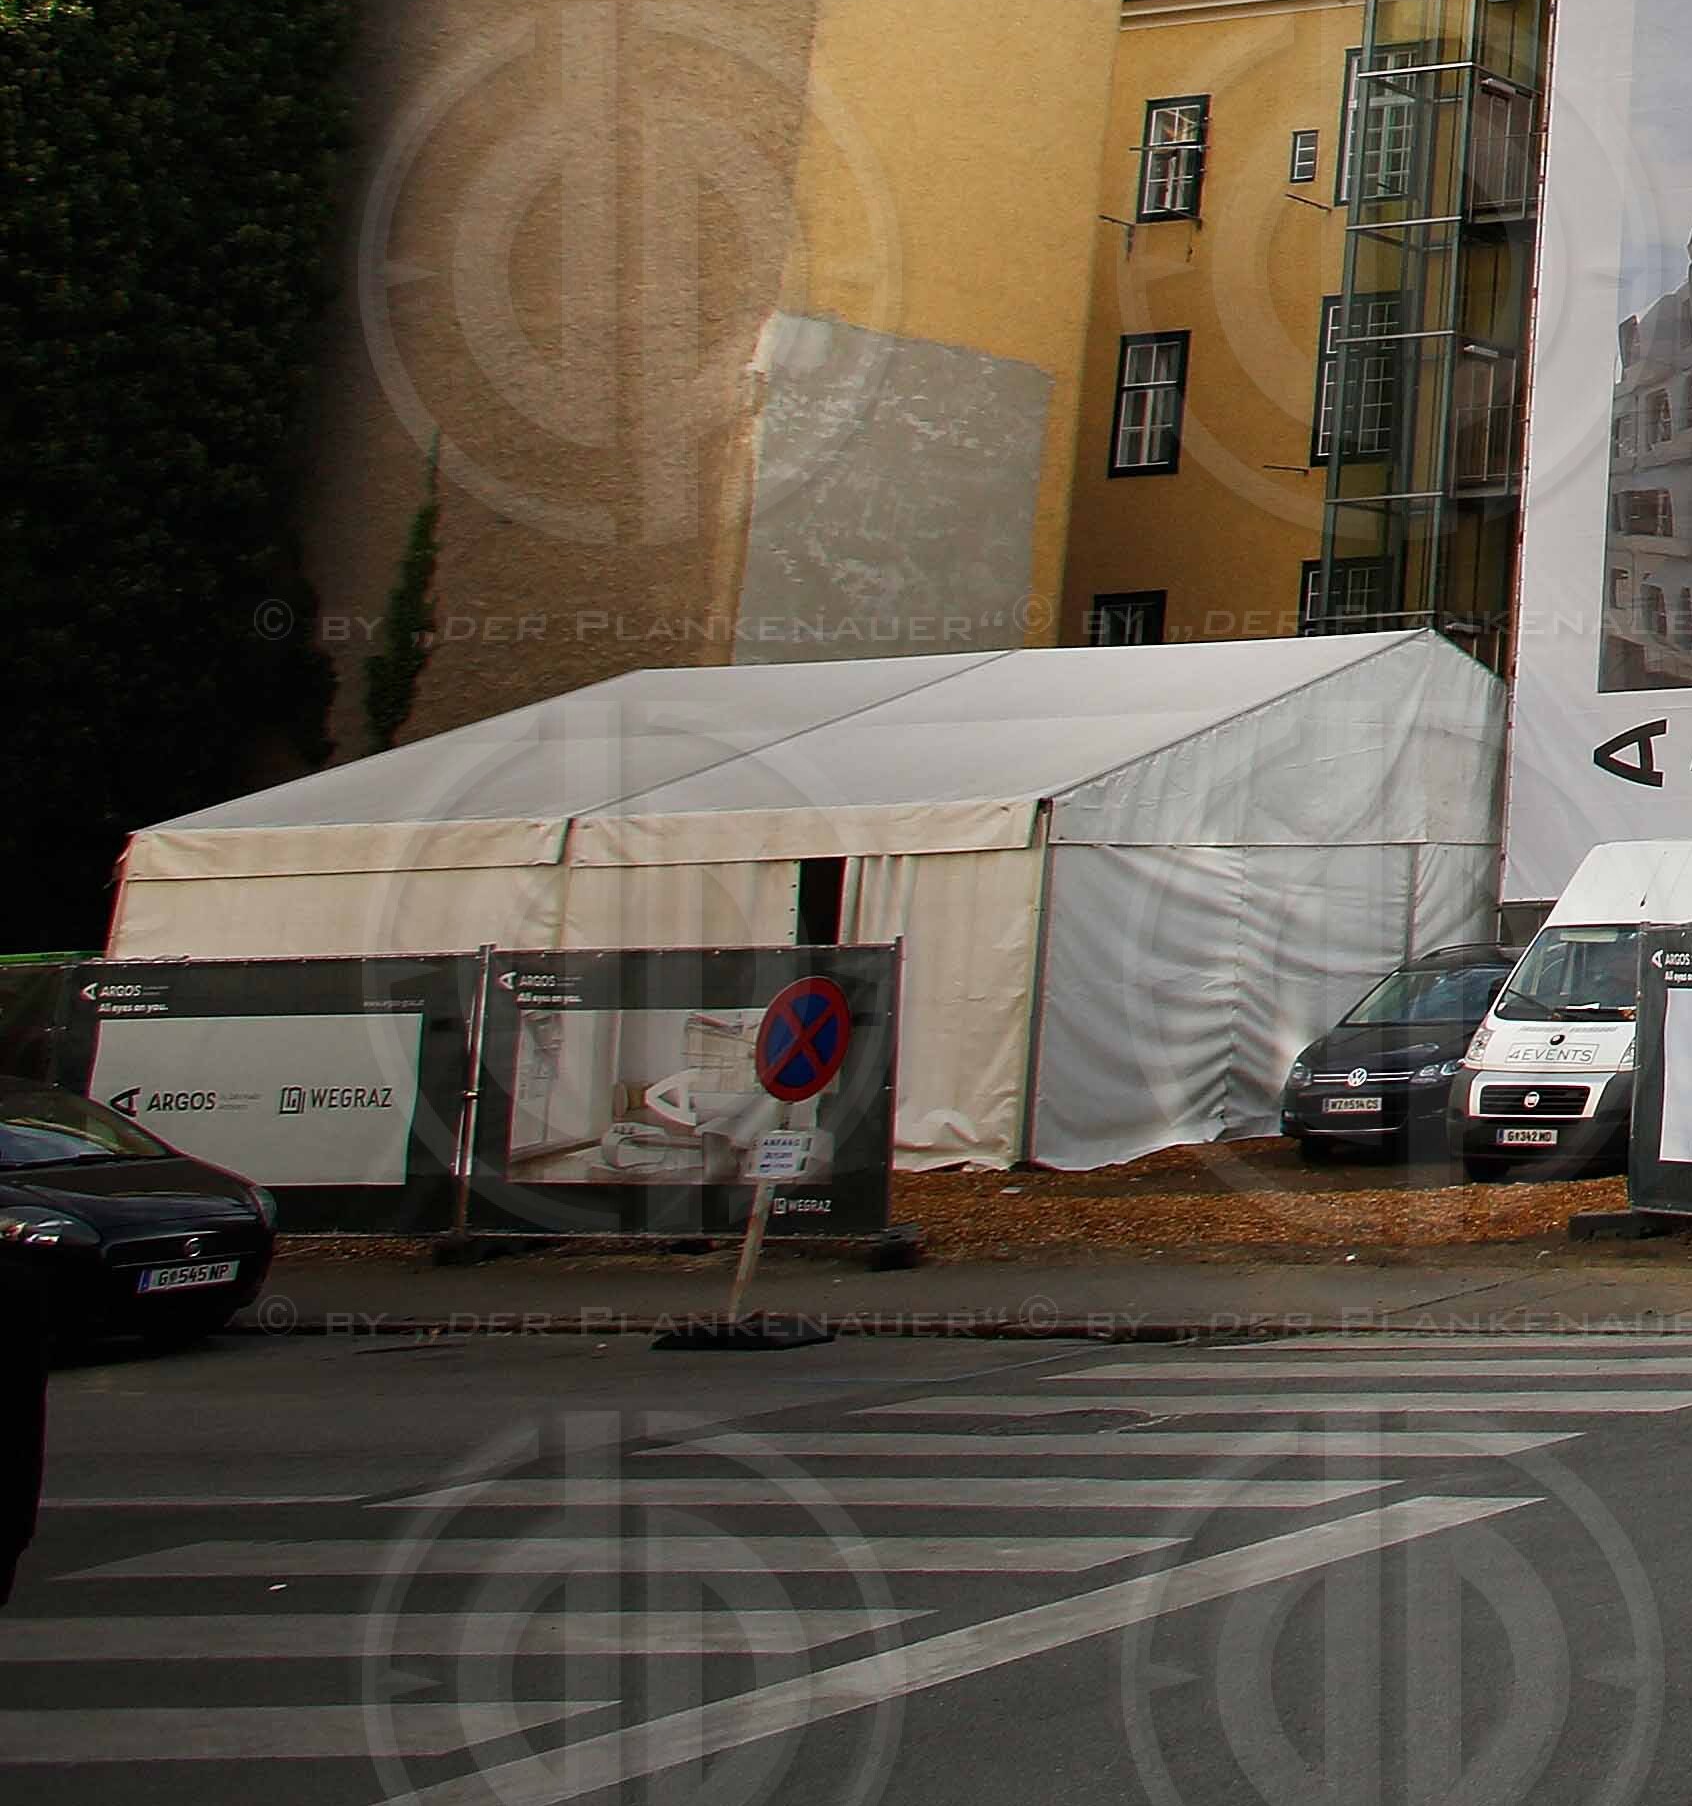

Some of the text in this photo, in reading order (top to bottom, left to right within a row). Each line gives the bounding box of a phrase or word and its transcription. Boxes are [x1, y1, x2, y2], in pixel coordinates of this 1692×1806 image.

[100, 985, 142, 997] ARGOS
[1509, 1049, 1592, 1062] 4EVENTS
[147, 1091, 217, 1112] ARGOS
[311, 1088, 392, 1108] WEGRAZ
